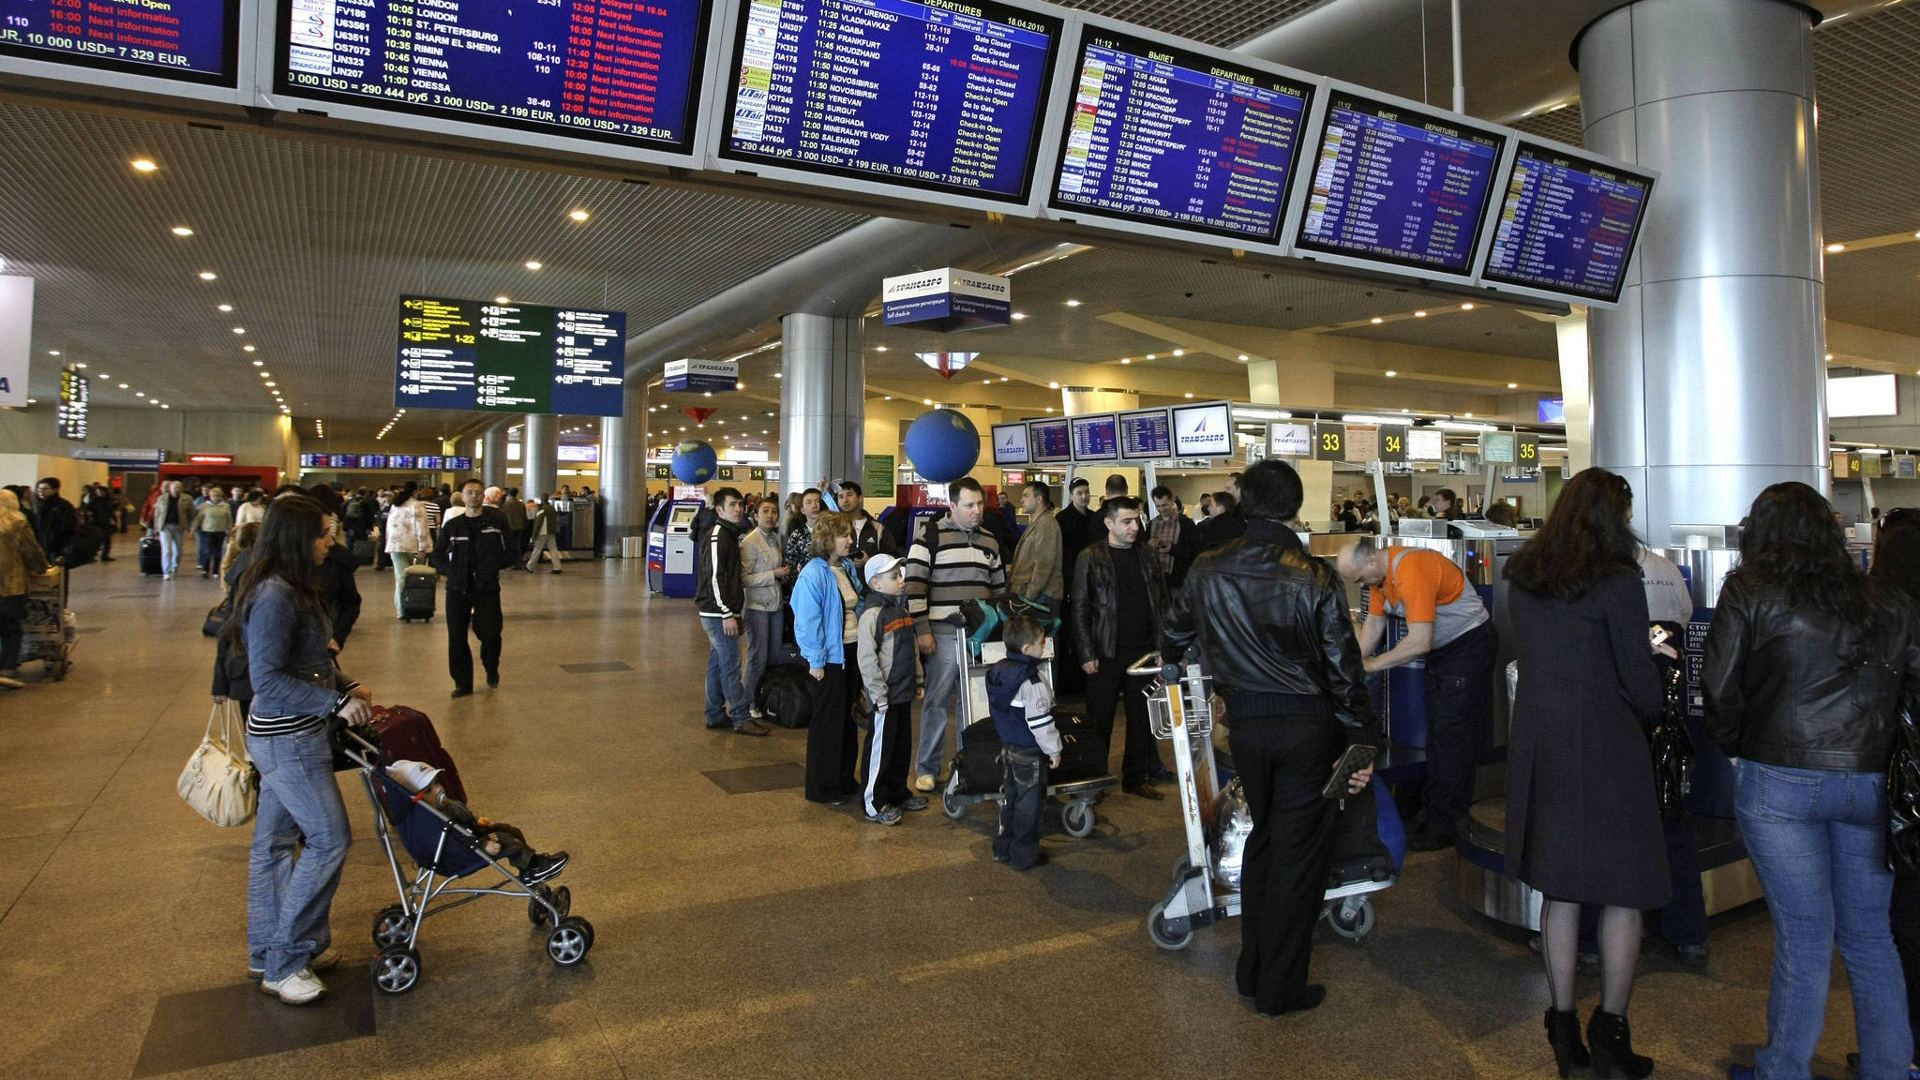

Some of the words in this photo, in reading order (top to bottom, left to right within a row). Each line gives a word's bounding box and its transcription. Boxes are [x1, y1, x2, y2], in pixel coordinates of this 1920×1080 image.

[142, 0, 171, 11] Open
[388, 3, 414, 14] 10:05
[416, 8, 458, 22] LONDON
[418, 0, 458, 10] LONDON
[843, 4, 863, 14] NOVY
[864, 8, 898, 22] URENGOJ
[924, 0, 982, 17] DEPARTURES
[7, 16, 28, 26] 110
[88, 4, 114, 15] Next
[118, 8, 179, 24] information
[600, 8, 632, 21] Delayed
[88, 15, 114, 27] Next
[117, 20, 179, 37] information
[387, 15, 412, 26] 10:15
[416, 20, 432, 30] ST.
[434, 24, 498, 42] PETERSBURG
[598, 18, 616, 30] Next
[618, 22, 664, 38] information
[820, 9, 838, 20] 11:20
[841, 14, 891, 31] VLADIKAVKAZ
[974, 34, 990, 44] Gate
[990, 38, 1012, 49] Closed
[50, 23, 81, 36] 10:00
[88, 28, 114, 40] Next
[117, 33, 179, 50] information
[335, 30, 369, 43] U63511
[386, 27, 412, 38] 10:30
[415, 32, 449, 46] SHARM
[452, 38, 464, 48] EL
[466, 40, 501, 54] SHEIKH
[816, 30, 836, 40] 11:40
[838, 34, 881, 50] FRANKFURT
[28, 33, 43, 44] 10
[48, 36, 72, 49] 000
[77, 40, 115, 54] USD=
[119, 47, 126, 57] 7
[131, 49, 154, 62] 329
[158, 53, 190, 66] EUR.
[385, 39, 411, 50] 10:35
[414, 44, 444, 56] RIMINI
[532, 41, 556, 52] 10-11
[334, 54, 364, 66] UN323
[384, 51, 410, 62] 10:45
[413, 56, 448, 68] VIENNA
[527, 52, 560, 64] 108-110
[568, 48, 590, 58] 11:40
[594, 52, 612, 63] Next
[614, 57, 659, 71] information
[834, 54, 870, 68] KOGALYM
[972, 54, 998, 66] Check-in
[998, 60, 1020, 70] Closed
[1094, 38, 1112, 48] 11:12
[1148, 51, 1174, 64] ВЫЛЕТ
[1210, 67, 1254, 84] DEPARTURES
[332, 66, 364, 78] UN207
[384, 63, 409, 74] 10:45
[412, 68, 448, 80] VIENNA
[535, 64, 550, 74] 110
[566, 59, 588, 70] 12:30
[593, 63, 612, 74] Next
[613, 68, 658, 82] information
[832, 64, 859, 76] NADYM
[382, 75, 408, 86] 11:00
[412, 80, 450, 92] ODESSA
[565, 70, 588, 80] 10:00
[592, 74, 610, 84] Next
[612, 78, 656, 92] information
[831, 74, 880, 90] NOVOSIBIRSK
[738, 88, 767, 99] UTair
[828, 94, 862, 107] YEREVAN
[830, 84, 878, 100] NOVOSIBIRSK
[964, 92, 991, 103] Check-in
[992, 96, 1008, 106] Open
[298, 74, 318, 85] 000
[323, 78, 348, 90] USD
[362, 84, 382, 96] 290
[384, 87, 404, 99] 444
[408, 92, 428, 102] руб
[434, 94, 440, 104] 3
[444, 95, 463, 107] 000
[466, 98, 495, 111] USD=
[501, 104, 507, 114] 2
[511, 106, 528, 117] 199
[531, 110, 556, 122] EUR,
[560, 114, 571, 125] 10
[574, 116, 591, 127] 000
[594, 118, 620, 131] USD=
[623, 124, 629, 132] 7
[631, 125, 648, 136] 329
[650, 128, 673, 140] EUR.
[527, 97, 551, 108] 38-40
[826, 104, 857, 116] SURGUT
[962, 101, 972, 109] Go
[980, 104, 994, 114] Gate
[588, 106, 606, 117] Next
[608, 110, 652, 124] information
[824, 114, 864, 128] HURGHADA
[822, 134, 860, 147] SALEHARD
[824, 124, 868, 138] MINERALNYE
[870, 132, 890, 142] VODY
[800, 140, 818, 150] 12:00
[820, 144, 858, 156] TASHKENT
[1322, 434, 1340, 450] 33
[1386, 436, 1401, 452] 34
[1520, 444, 1535, 458] 35
[722, 469, 730, 477] 13
